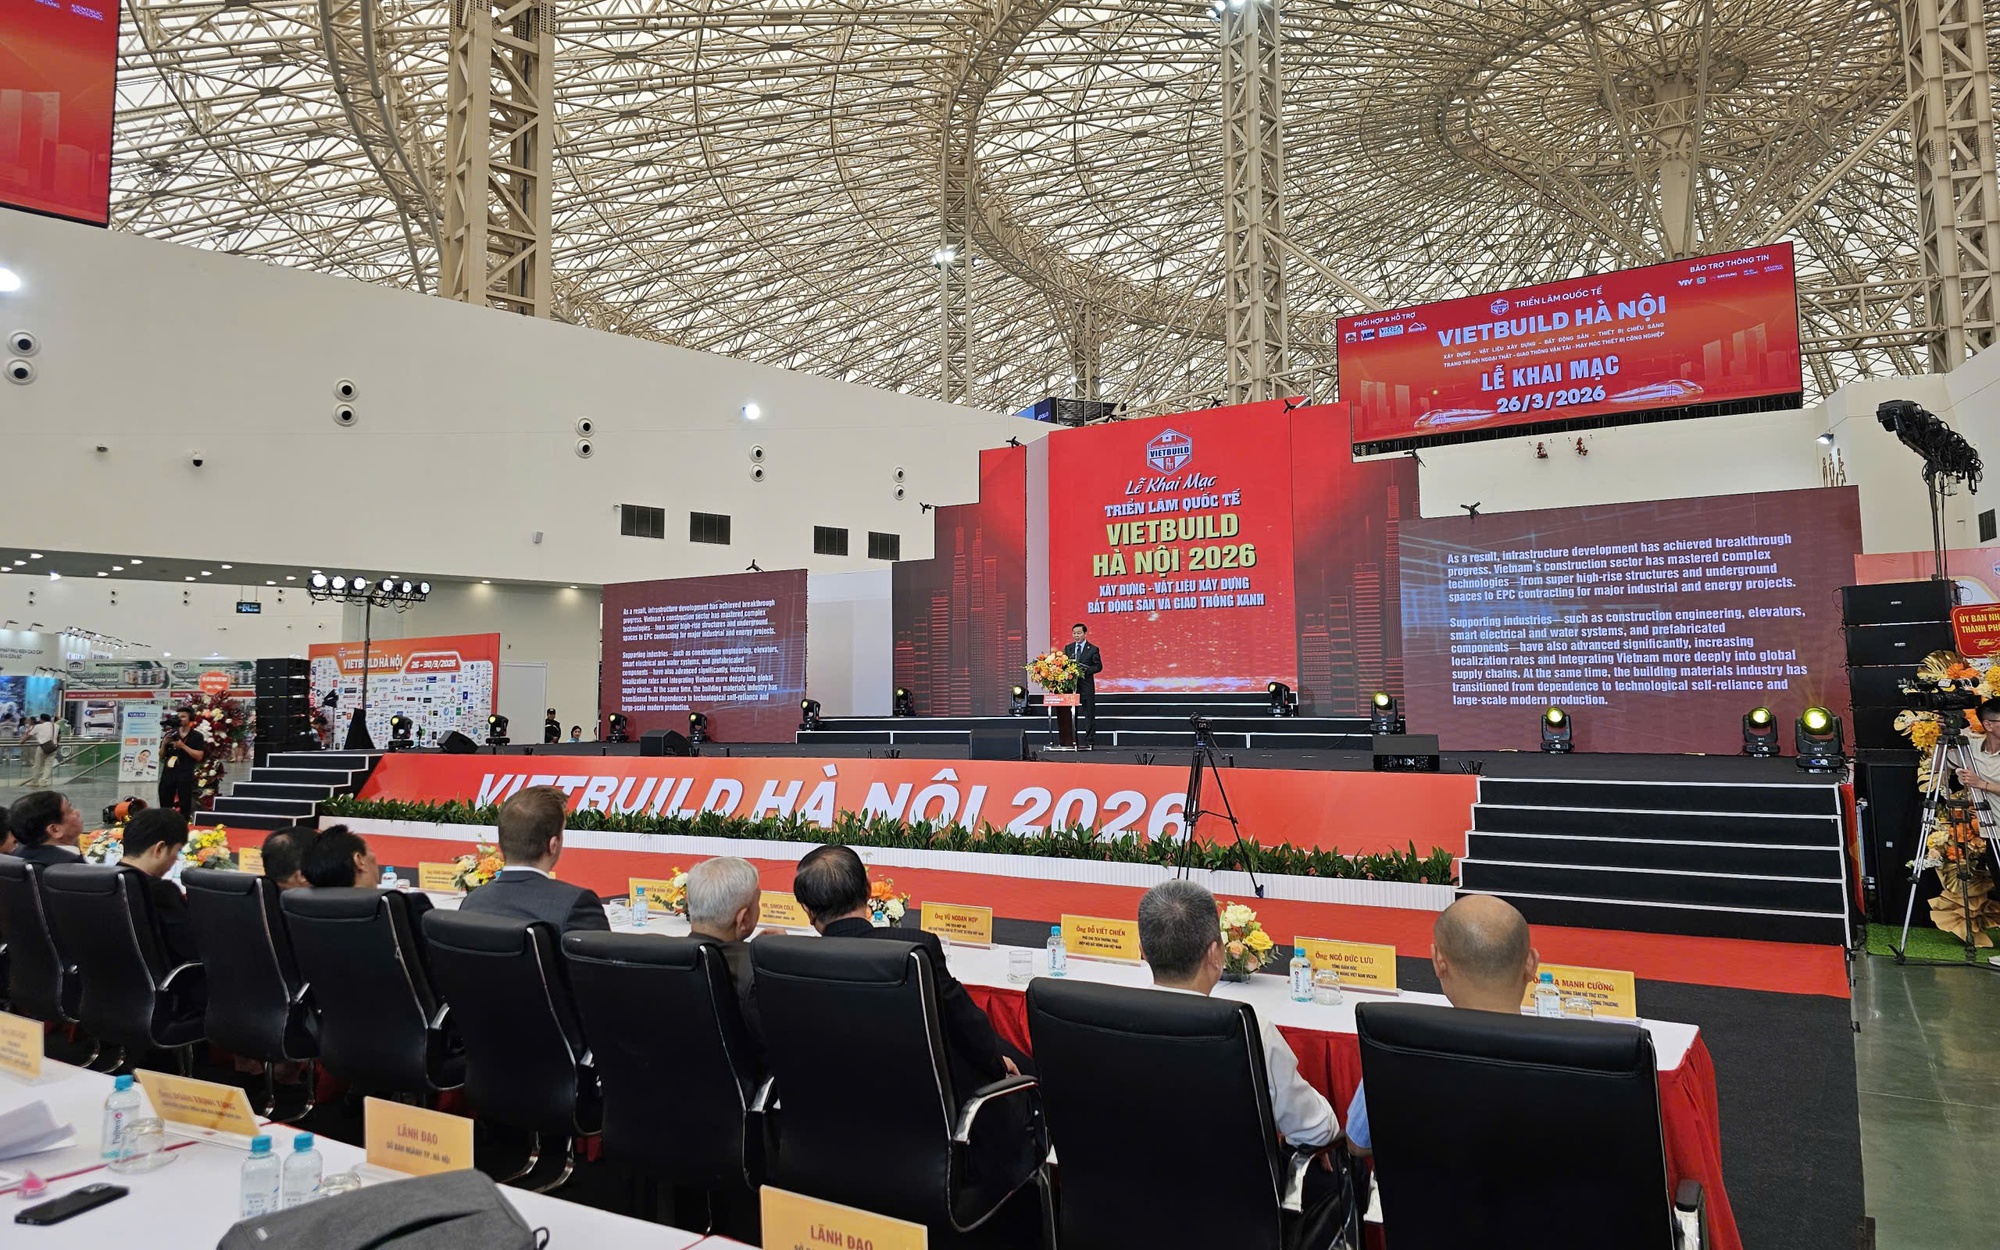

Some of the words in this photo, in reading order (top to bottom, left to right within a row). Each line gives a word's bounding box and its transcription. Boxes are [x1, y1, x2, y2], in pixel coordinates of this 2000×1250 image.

[1690, 264, 1706, 273] BẢO
[1726, 257, 1754, 266] THÔNG
[1515, 296, 1540, 308] TRIỂN
[1562, 288, 1589, 300] QUỐC
[1591, 285, 1603, 295] TẾ
[1438, 312, 1569, 347] VIETBUILD
[1575, 299, 1612, 326] HÀ
[1618, 292, 1666, 322] NỘI
[1481, 364, 1505, 392] LỄ
[1513, 363, 1562, 387] KHAI
[1570, 355, 1619, 380] MẠC
[1496, 385, 1606, 413] 26/3/2026
[1150, 447, 1189, 457] VIETBUILD
[1125, 477, 1147, 496] Lễ
[1146, 476, 1182, 493] Khai
[1183, 473, 1217, 492] Mạc
[1104, 498, 1145, 517] TRIỂN
[1182, 492, 1219, 512] QUỐC
[1222, 489, 1241, 506] TẾ
[1106, 514, 1239, 546] VIETBUILD
[1448, 553, 1459, 563] As
[1462, 555, 1467, 563] a
[1470, 552, 1500, 562] result,
[1503, 548, 1568, 561] infrastructure
[1572, 543, 1638, 557] development
[1641, 542, 1659, 552] has
[1663, 538, 1712, 551] achieved
[1716, 533, 1792, 547] breakthrough
[1093, 549, 1127, 576] HÀ
[1134, 545, 1180, 578] NỘI
[1188, 544, 1257, 571] 2026
[1448, 566, 1491, 577] progress.
[1494, 560, 1541, 574] Vietnam's
[1544, 558, 1607, 572] construction
[1610, 557, 1642, 568] sector
[1646, 556, 1664, 566] has
[1668, 552, 1718, 565] mastered
[1722, 550, 1771, 562] complex
[1448, 576, 1543, 589] technologies—from
[1546, 575, 1573, 586] super
[1576, 571, 1622, 584] high-rise
[1626, 568, 1679, 581] structures
[1683, 567, 1702, 577] and
[1706, 563, 1777, 577] underground
[1100, 584, 1116, 597] XÂY
[1119, 582, 1146, 597] DỰNG
[1175, 580, 1196, 594] LIỆU
[1199, 578, 1218, 591] XÂY
[1221, 577, 1250, 591] DỰNG
[1449, 592, 1482, 603] spaces
[1484, 591, 1493, 600] to
[1496, 590, 1515, 600] EPC
[1518, 587, 1574, 599] contracting
[1577, 586, 1591, 596] for
[1594, 585, 1624, 596] major
[1628, 581, 1678, 594] industrial
[1681, 581, 1701, 592] and
[1705, 580, 1742, 591] energy
[1746, 577, 1796, 590] projects.
[1158, 599, 1171, 610] VÀ
[1174, 597, 1197, 609] GIAO
[1200, 595, 1234, 608] THÔNG
[1237, 593, 1265, 606] XANH
[1450, 616, 1500, 628] Supporting
[1504, 613, 1588, 626] industries—such
[1591, 614, 1603, 622] as
[1606, 610, 1672, 622] construction
[1676, 608, 1745, 620] engineering,
[1749, 607, 1806, 618] elevators,
[1960, 614, 1969, 623] ỦY
[1450, 629, 1477, 640] smart
[1480, 628, 1526, 639] electrical
[1529, 627, 1547, 638] and
[1550, 627, 1578, 638] water
[1581, 626, 1627, 638] systems,
[1630, 625, 1649, 636] and
[1652, 623, 1726, 636] prefabricated
[1961, 624, 1986, 633] THÀNH
[1451, 641, 1543, 654] components—have
[1547, 640, 1567, 651] also
[1571, 639, 1620, 650] advanced
[1623, 638, 1692, 650] significantly,
[1695, 636, 1754, 648] increasing
[379, 654, 389, 668] HÀ
[1452, 656, 1508, 666] localization
[1510, 655, 1535, 665] rates
[1538, 654, 1556, 664] and
[1558, 653, 1614, 665] integrating
[1616, 652, 1659, 663] Vietnam
[1662, 653, 1691, 662] more
[1694, 651, 1731, 662] deeply
[1734, 650, 1756, 661] into
[1760, 650, 1796, 661] global
[1452, 669, 1483, 680] supply
[1485, 668, 1520, 679] chains.
[1523, 668, 1533, 678] At
[1536, 668, 1551, 678] the
[1554, 668, 1581, 677] same
[1584, 667, 1611, 678] time,
[1614, 667, 1630, 677] the
[1634, 666, 1677, 677] building
[1681, 665, 1733, 676] materials
[1736, 664, 1783, 676] industry
[1786, 664, 1807, 674] has
[1452, 682, 1509, 692] transitioned
[1512, 682, 1534, 691] from
[1537, 681, 1599, 692] dependence
[1602, 682, 1611, 691] to
[1615, 680, 1688, 692] technological
[1692, 680, 1763, 690] self-reliance
[1767, 679, 1788, 690] and
[1453, 695, 1508, 706] large-scale
[1510, 695, 1548, 705] modern
[1550, 695, 1608, 706] production.
[748, 763, 838, 828] HÀ
[1005, 787, 1193, 845] 2026
[1316, 951, 1327, 960] Ông
[1330, 952, 1342, 960] NGÔ
[1344, 953, 1359, 963] ĐỨC
[1562, 980, 1584, 989] MẠNH
[1587, 981, 1614, 991] CƯỜNG
[811, 1224, 842, 1247] LÃNH
